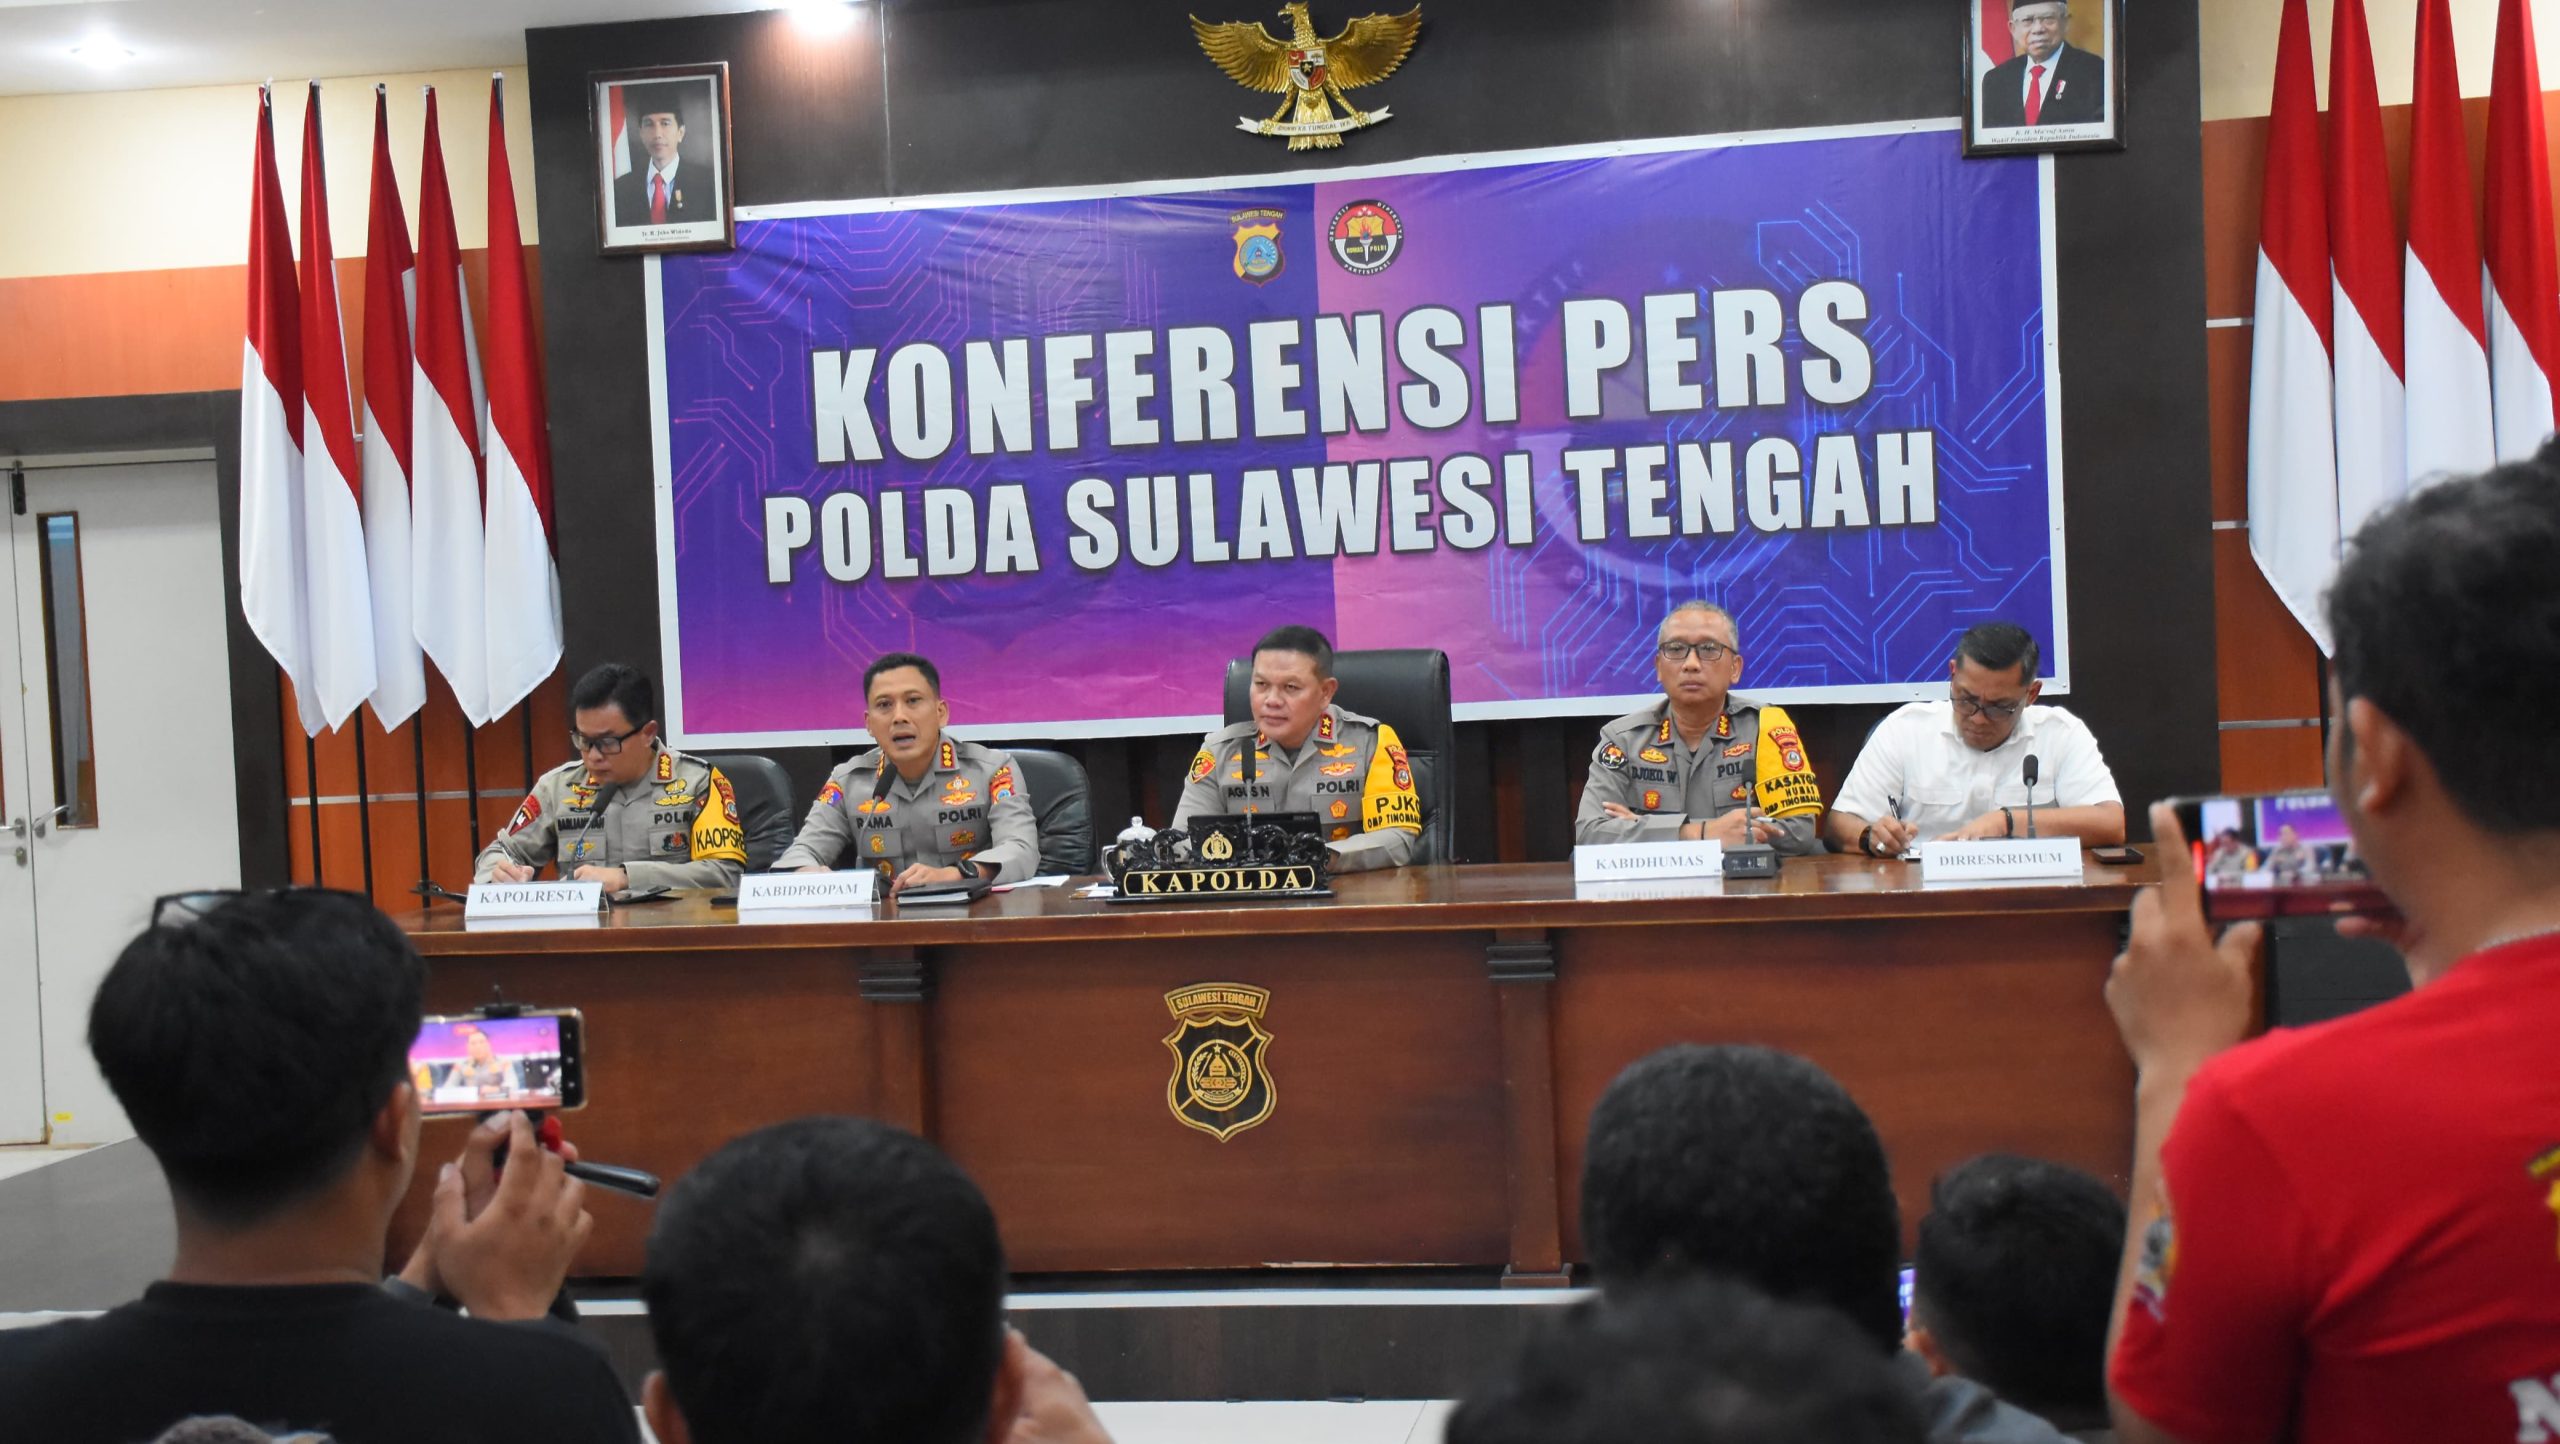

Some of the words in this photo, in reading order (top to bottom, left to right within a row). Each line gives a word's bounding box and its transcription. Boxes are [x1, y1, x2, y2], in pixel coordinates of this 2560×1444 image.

[812, 304, 1519, 463] KONFERENSI
[1563, 281, 1872, 418] PERS
[764, 484, 1040, 584] POLDA
[1066, 451, 1534, 570] SULAWESI
[1563, 430, 1937, 541] TENGAH
[1666, 769, 1678, 784] W
[1717, 764, 1744, 778] POL
[1260, 786, 1270, 798] N
[1316, 779, 1360, 794] POLRI
[1785, 786, 1815, 797] HUMAS
[856, 815, 893, 830] RAMA
[938, 807, 983, 825] POLRI
[1367, 816, 1383, 829] OMP
[1596, 855, 1704, 870] KABIDHUMAS
[1939, 852, 2063, 866] DIRRESKRIMUM
[1141, 868, 1301, 893] KAPOLDA
[480, 889, 584, 904] KAPOLRESTA
[752, 883, 858, 897] KABIDPROPAM
[1176, 991, 1220, 1009] SULAWESI
[1222, 992, 1257, 1007] TENGAH
